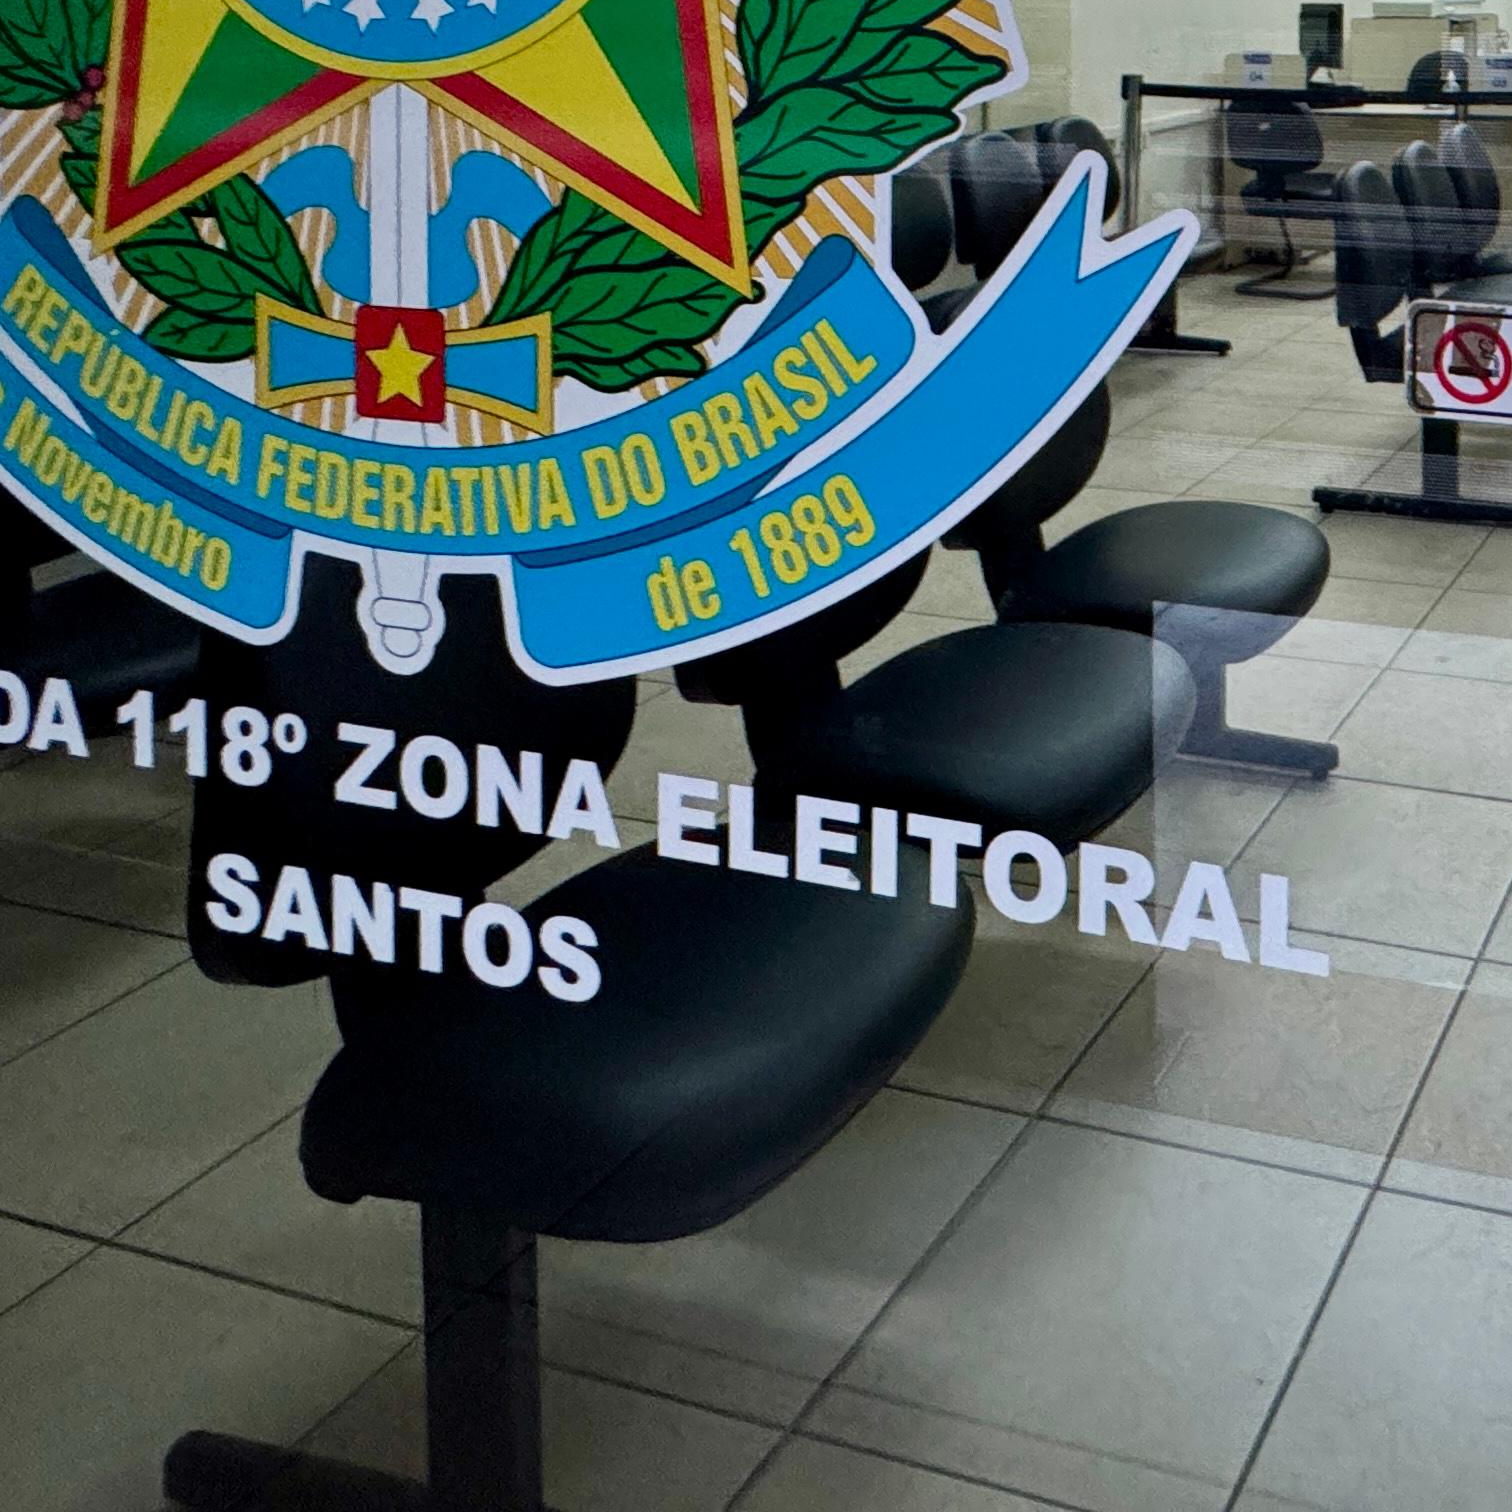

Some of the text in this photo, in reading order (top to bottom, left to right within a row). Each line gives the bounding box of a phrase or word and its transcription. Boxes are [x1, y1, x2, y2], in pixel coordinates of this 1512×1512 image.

[2, 263, 877, 537] REPÚBLICA FEDERATIVA DO BRASIL
[4, 407, 233, 593] Novembro
[645, 473, 876, 631] de 1889
[204, 852, 603, 1003] SANTOS
[333, 721, 621, 849] ZONA
[656, 772, 1330, 977] ELEITORAL
